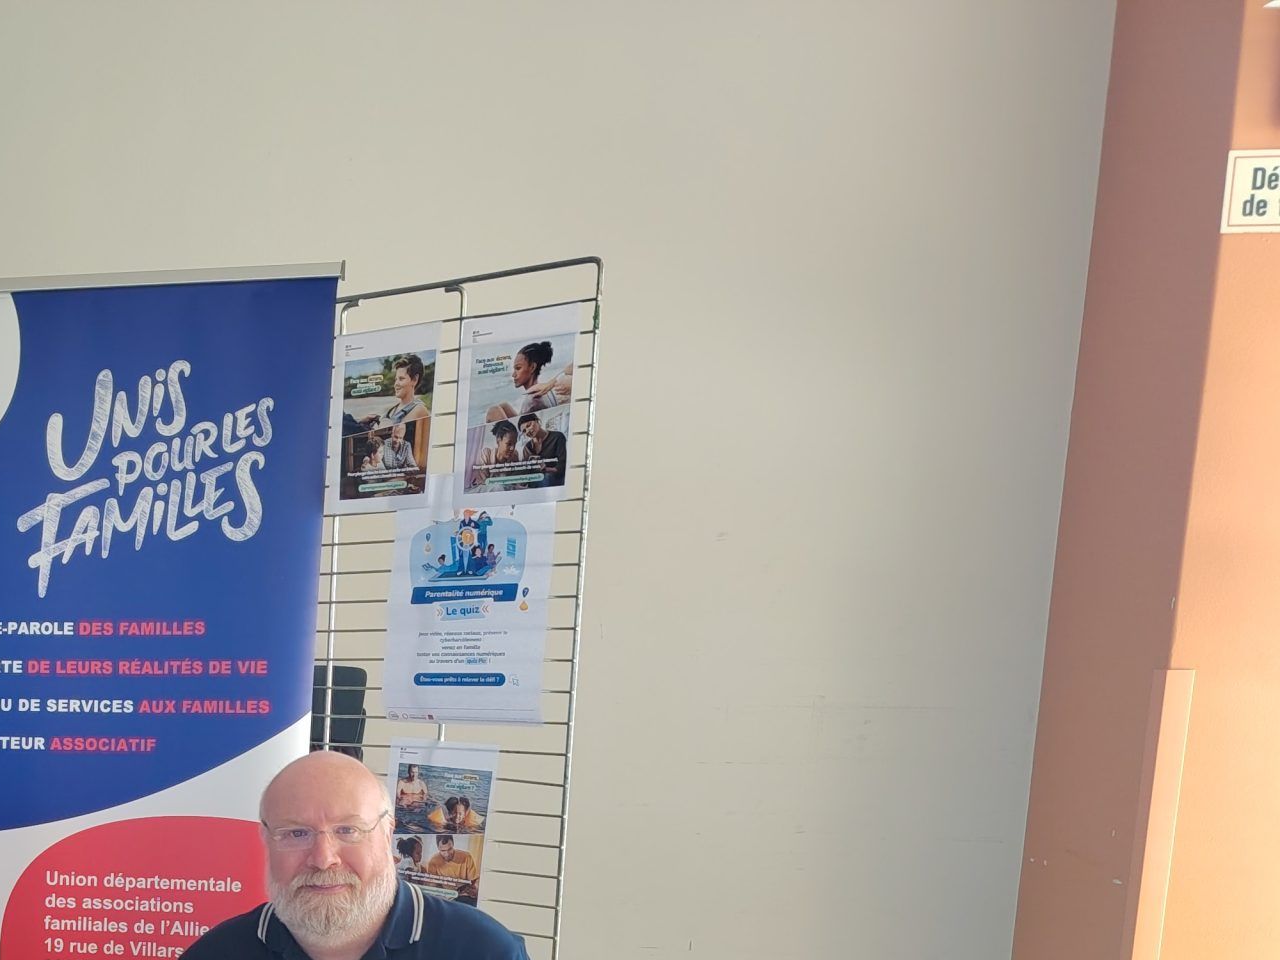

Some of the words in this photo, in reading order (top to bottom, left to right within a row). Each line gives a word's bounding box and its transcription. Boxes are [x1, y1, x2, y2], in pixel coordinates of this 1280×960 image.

[1251, 166, 1280, 190] Dé
[1242, 193, 1268, 217] de
[222, 397, 274, 453] LES
[425, 589, 464, 598] Parentalité
[465, 589, 503, 597] numérique
[446, 606, 457, 615] Le
[459, 605, 480, 616] quiz
[79, 622, 114, 636] DES
[119, 621, 206, 636] FAMILLES
[27, 661, 50, 674] DE
[56, 661, 113, 675] LEURS
[119, 658, 203, 675] RÉALITÉS
[209, 662, 231, 675] DE
[237, 661, 268, 675] VIE
[18, 700, 40, 712] DE
[47, 699, 134, 713] SERVICES
[139, 700, 176, 714] AUX
[182, 700, 270, 714] FAMILLES
[50, 737, 157, 752] ASSOCIATIF
[45, 871, 98, 887] Union
[103, 873, 242, 892] départementale
[45, 894, 76, 909] des
[82, 896, 194, 913] associations
[44, 916, 128, 933] familiales
[134, 919, 155, 935] de
[160, 920, 210, 937] l'Allie
[44, 938, 64, 953] 19
[70, 941, 98, 954] rue
[103, 940, 125, 955] de
[130, 941, 185, 959] Villars
